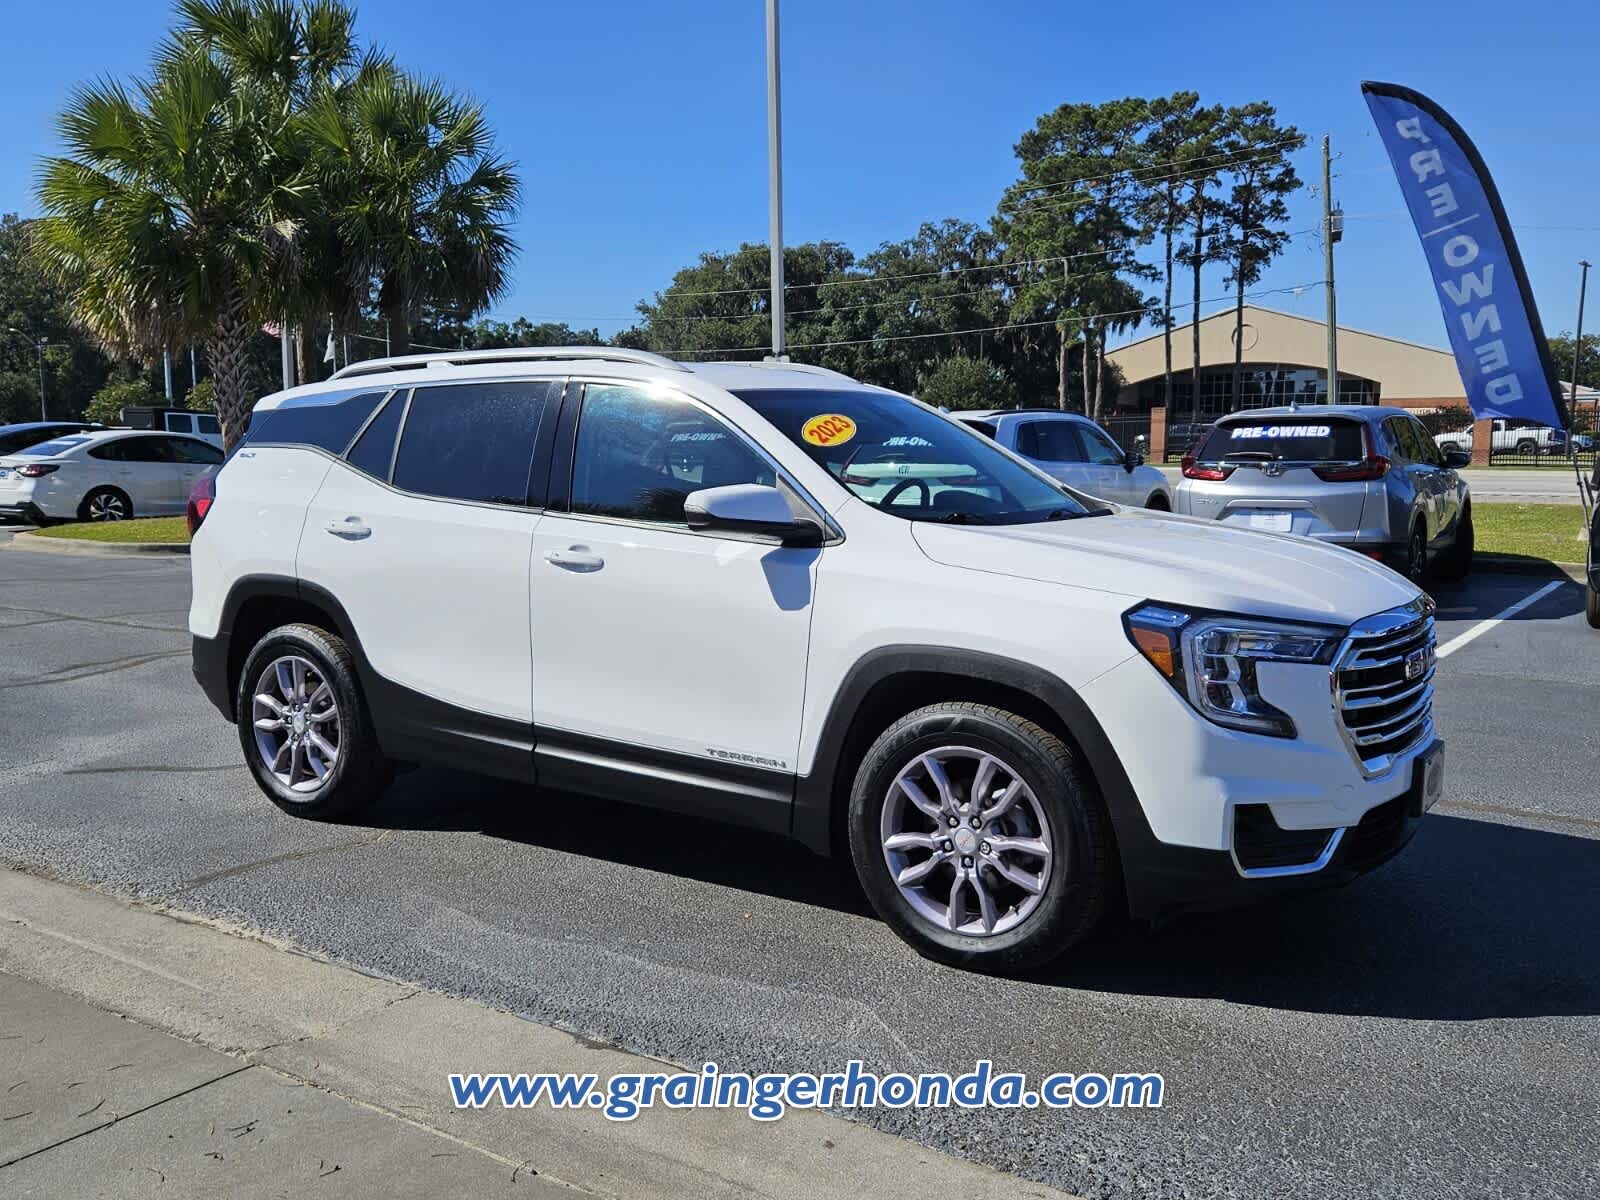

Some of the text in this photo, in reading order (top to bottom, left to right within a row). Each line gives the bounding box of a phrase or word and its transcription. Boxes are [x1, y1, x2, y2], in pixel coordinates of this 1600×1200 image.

[809, 415, 851, 444] 2023
[1231, 426, 1331, 439] PRE-OWNED
[706, 747, 787, 769] TERRAIN
